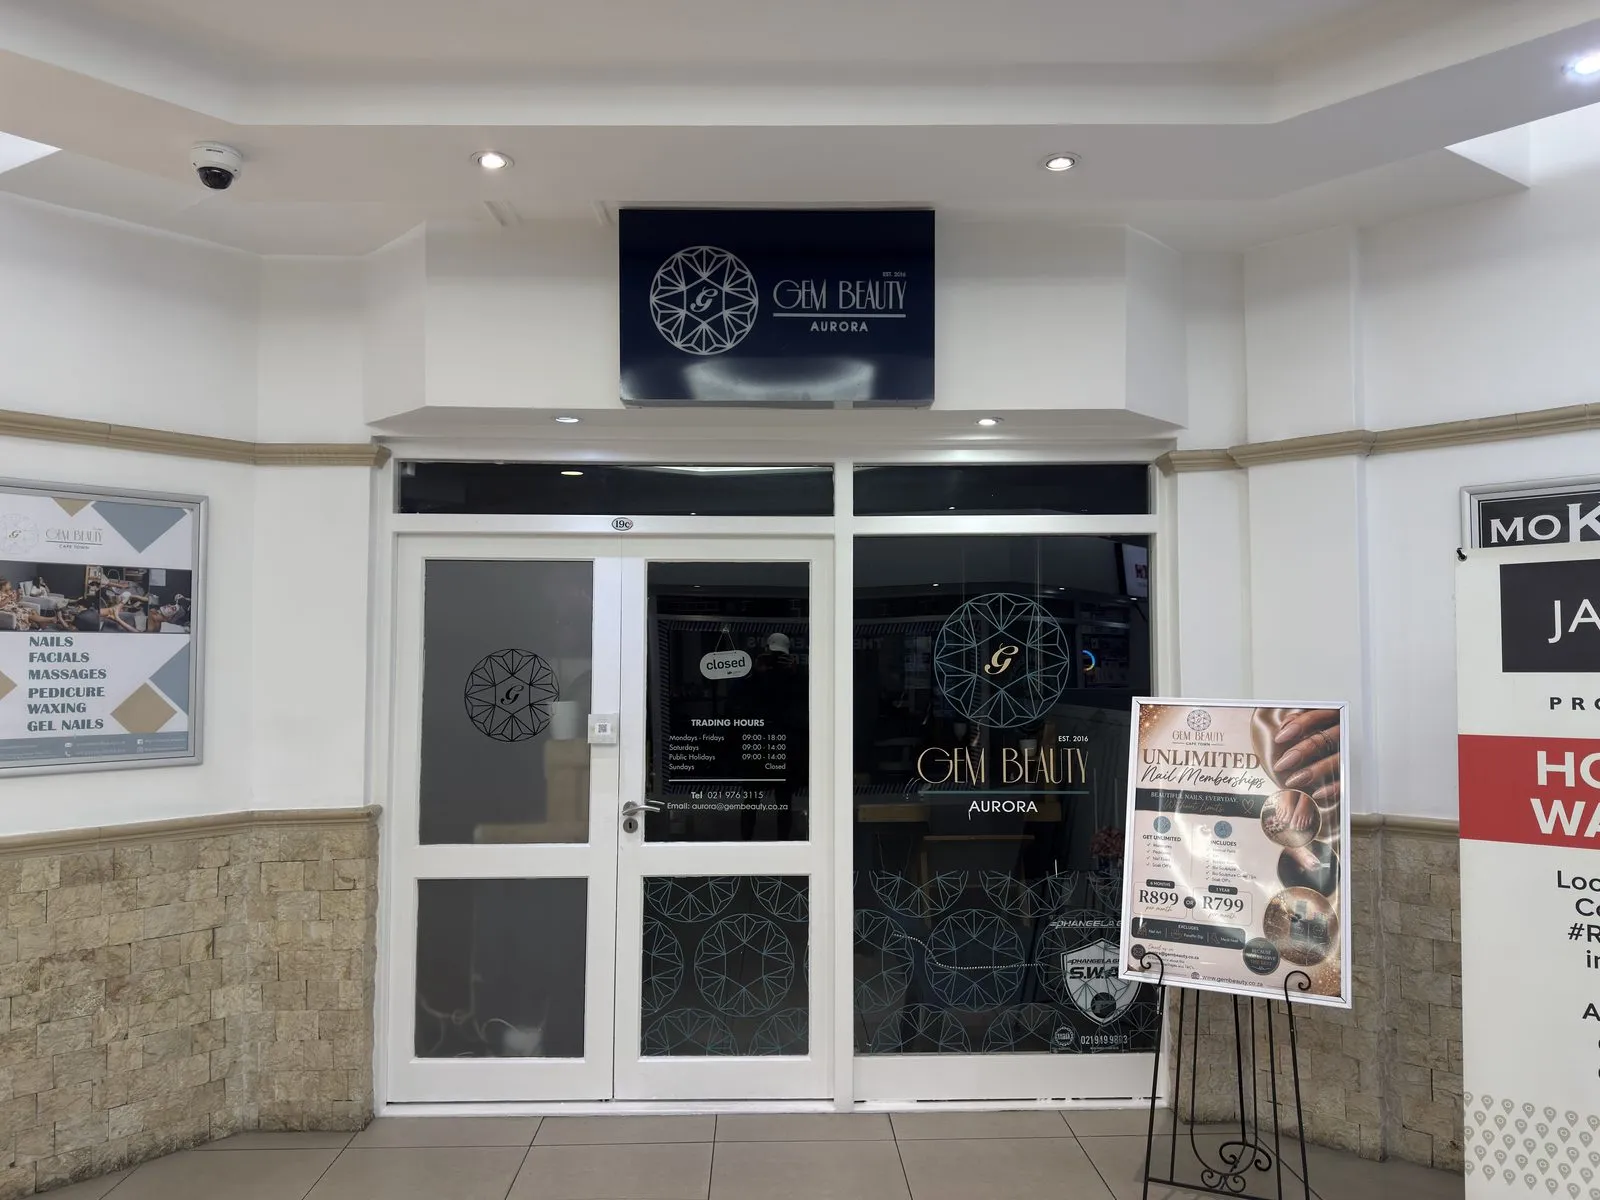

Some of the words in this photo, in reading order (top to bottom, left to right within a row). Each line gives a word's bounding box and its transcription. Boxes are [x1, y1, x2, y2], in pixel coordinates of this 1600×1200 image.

[773, 279, 826, 309] GEM
[838, 279, 906, 310] BEAUTY
[810, 321, 868, 332] AURORA
[29, 636, 73, 647] NAILS
[29, 652, 89, 663] FACIALS
[706, 657, 745, 670] closed
[28, 668, 106, 680] MASSAGES
[28, 686, 105, 699] PEDICURE
[27, 703, 86, 714] WAXING
[27, 720, 57, 732] GEL
[61, 719, 104, 731] NAILS
[1172, 730, 1190, 740] GEM
[1195, 731, 1224, 742] BEAUTY
[1143, 749, 1260, 769] UNLIMITED
[917, 747, 985, 785] GEM
[1002, 747, 1088, 784] BEAUTY
[1141, 766, 1177, 783] Nail
[1178, 766, 1266, 790] Memberships
[692, 802, 788, 811] aurora@gembeauty.co.za
[969, 800, 1038, 813] AURORA
[1139, 890, 1178, 906] R899
[1202, 896, 1244, 912] R799
